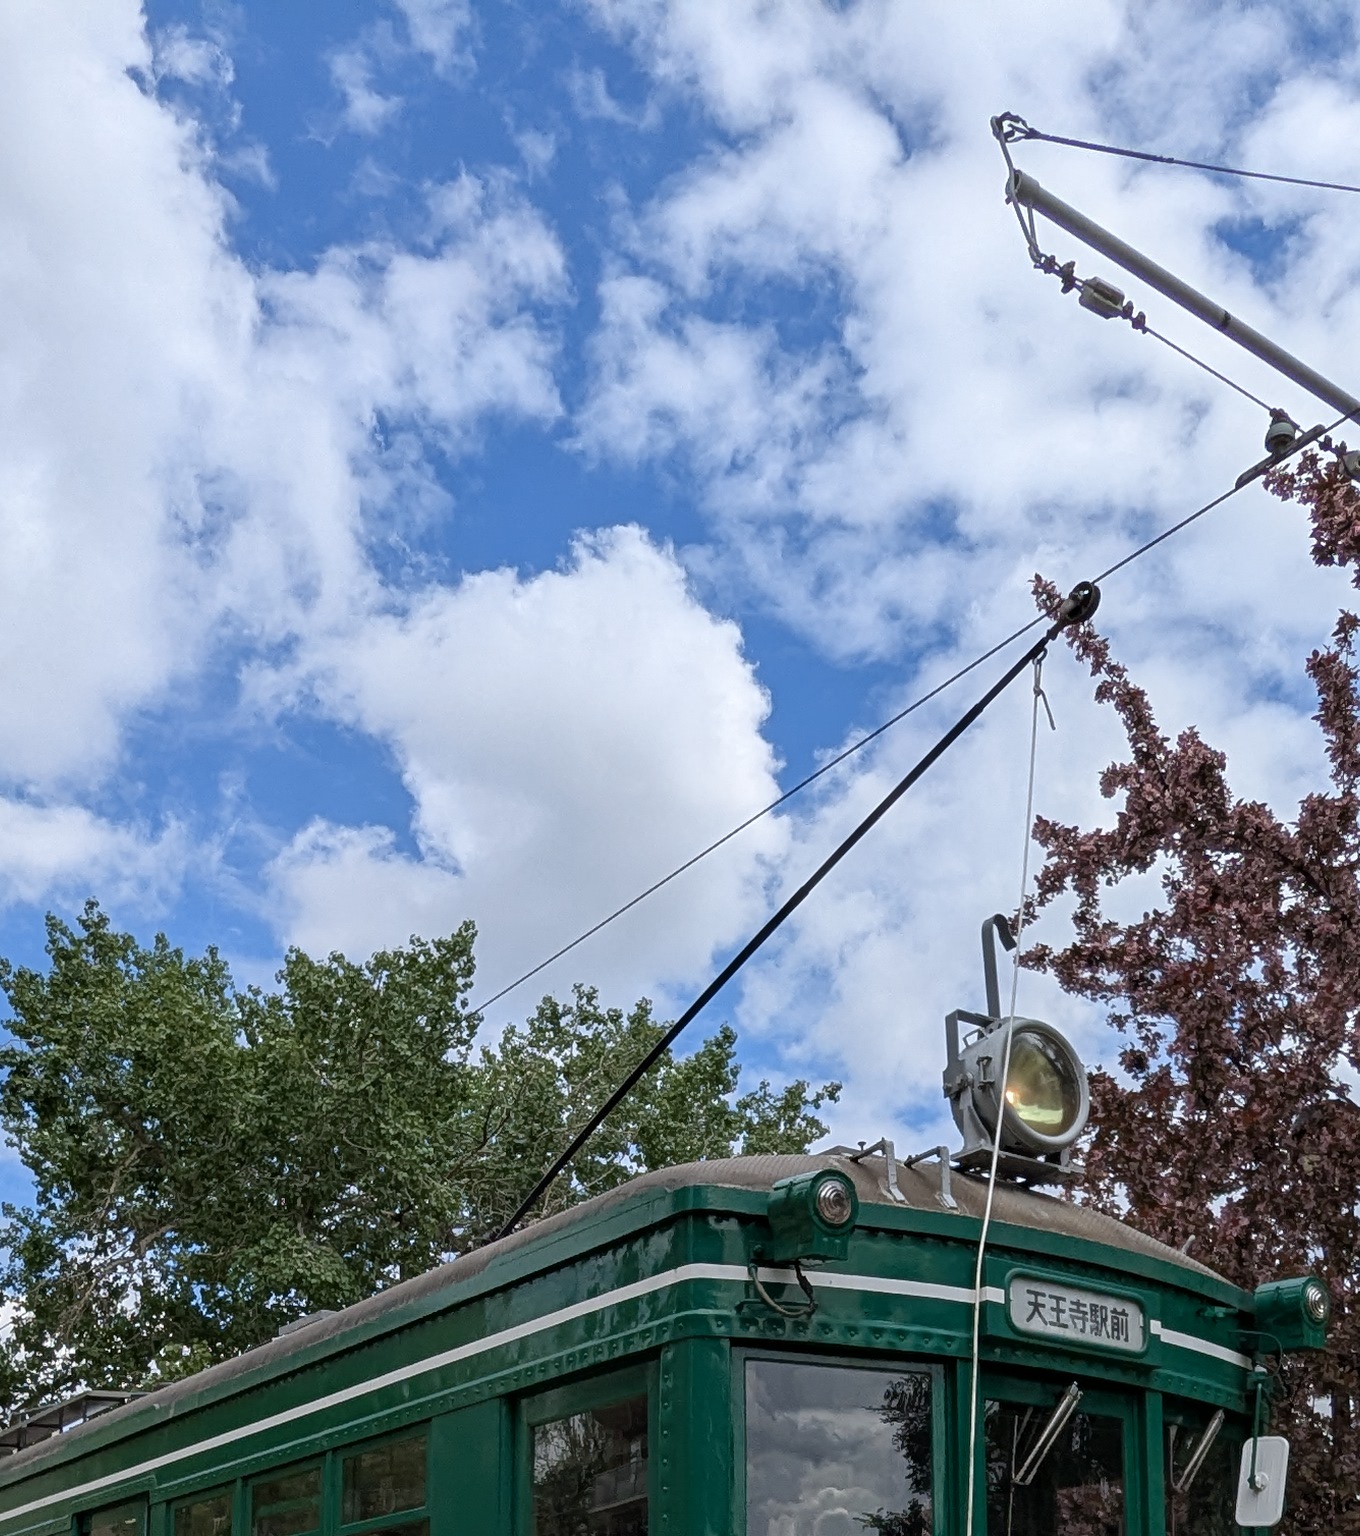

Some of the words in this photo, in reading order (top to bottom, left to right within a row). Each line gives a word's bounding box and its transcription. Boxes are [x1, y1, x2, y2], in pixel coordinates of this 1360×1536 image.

[1026, 1289, 1129, 1342] 天王寺駅前
